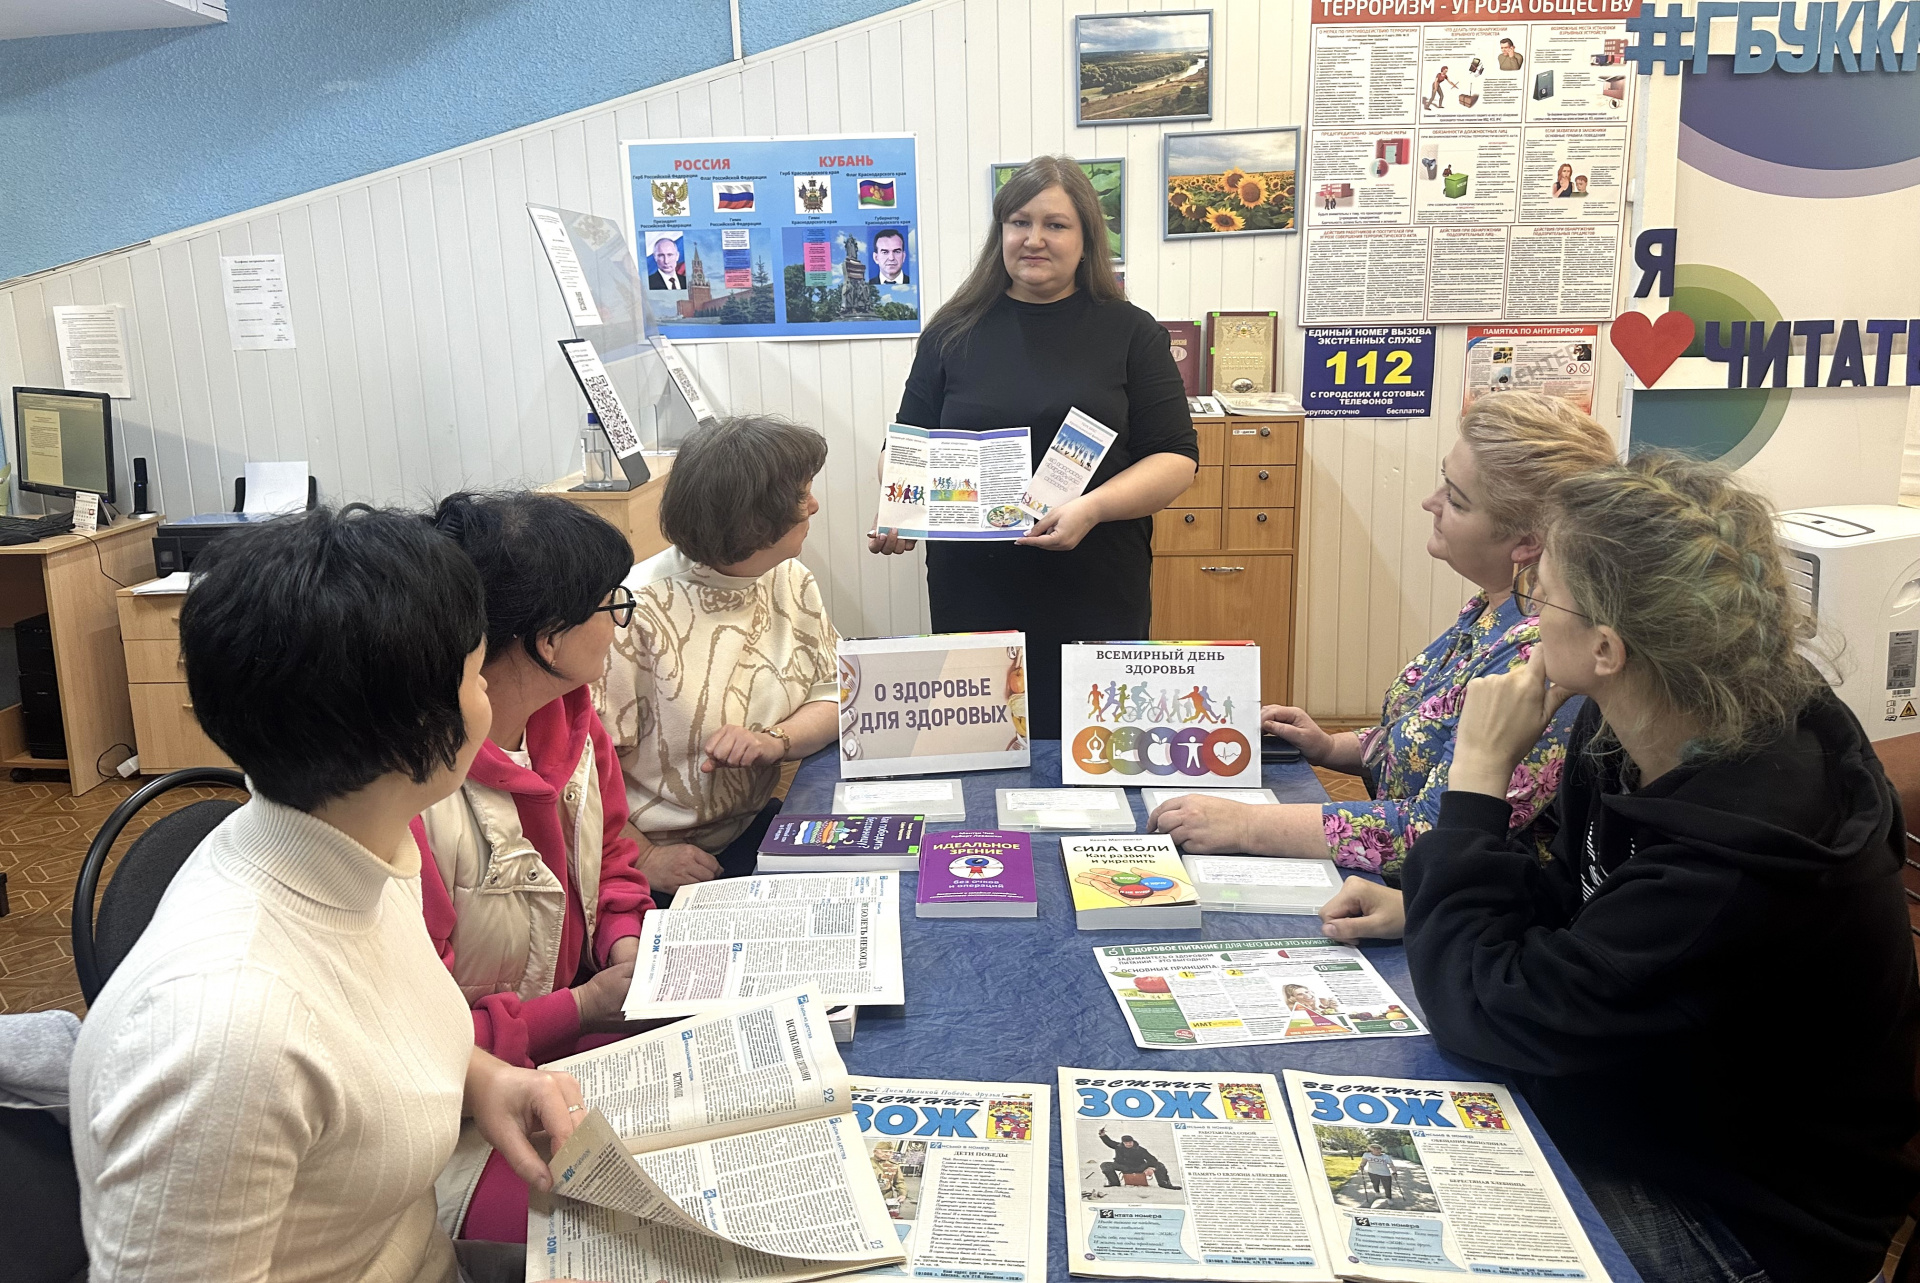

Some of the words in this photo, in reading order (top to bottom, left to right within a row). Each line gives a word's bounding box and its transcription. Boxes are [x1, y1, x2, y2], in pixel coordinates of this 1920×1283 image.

[1320, 0, 1435, 16] ТЕРРОРИЗМ
[1451, 0, 1523, 15] УГРОЗА
[1528, 0, 1633, 15] ОБЩЕСТВУ
[674, 159, 731, 171] РОССИЯ
[819, 155, 874, 167] КУБАНЬ
[1633, 228, 1678, 298] Я
[1308, 328, 1353, 337] ЕДИНЫЙ
[1355, 328, 1390, 336] НОМЕР
[1318, 337, 1385, 345] ЭКСТРЕННЫХ
[1388, 336, 1422, 344] СЛУЖБ
[1326, 350, 1413, 385] 112
[1319, 391, 1371, 399] ГОРОДСКИХ
[1382, 390, 1425, 398] СОТОВЫХ
[1096, 649, 1184, 660] ВСЕМИРНЫЙ
[1188, 651, 1225, 662] ДЕНЬ
[1125, 665, 1195, 676] ЗДОРОВЬЯ
[874, 683, 886, 702] О
[892, 677, 992, 704] ЗДОРОВЬЕ
[859, 711, 900, 734] ДЛЯ
[905, 704, 1008, 731] ЗДОРОВЫХ
[879, 816, 892, 824] Как
[856, 816, 878, 849] бессонницу?
[873, 824, 889, 850] победить
[933, 842, 1021, 851] ИДЕАЛЬНОЕ
[860, 908, 869, 936] БОЛЕТЬ
[652, 934, 662, 953] ЗОЖ
[1129, 945, 1177, 954] ЗДОРОВОЕ
[1178, 943, 1219, 951] ПИТАНИЕ
[858, 936, 868, 970] НЕКОГДА
[786, 1018, 803, 1060] ИСПЫТАНИЕ
[1074, 1078, 1213, 1090] ВЕСТНИК
[1302, 1081, 1444, 1098] ВЕСТНИК
[823, 1088, 835, 1103] 22
[906, 1088, 939, 1096] Великой
[851, 1093, 984, 1107] ВЕСТНИК
[1076, 1088, 1219, 1120] ЗОЖ
[1307, 1091, 1457, 1128] ЗОЖ
[852, 1102, 980, 1139] ЗОЖ
[975, 1151, 1009, 1159] ПОБЕДЫ
[546, 1235, 557, 1255] ЗОЖ
[870, 1239, 884, 1250] 23
